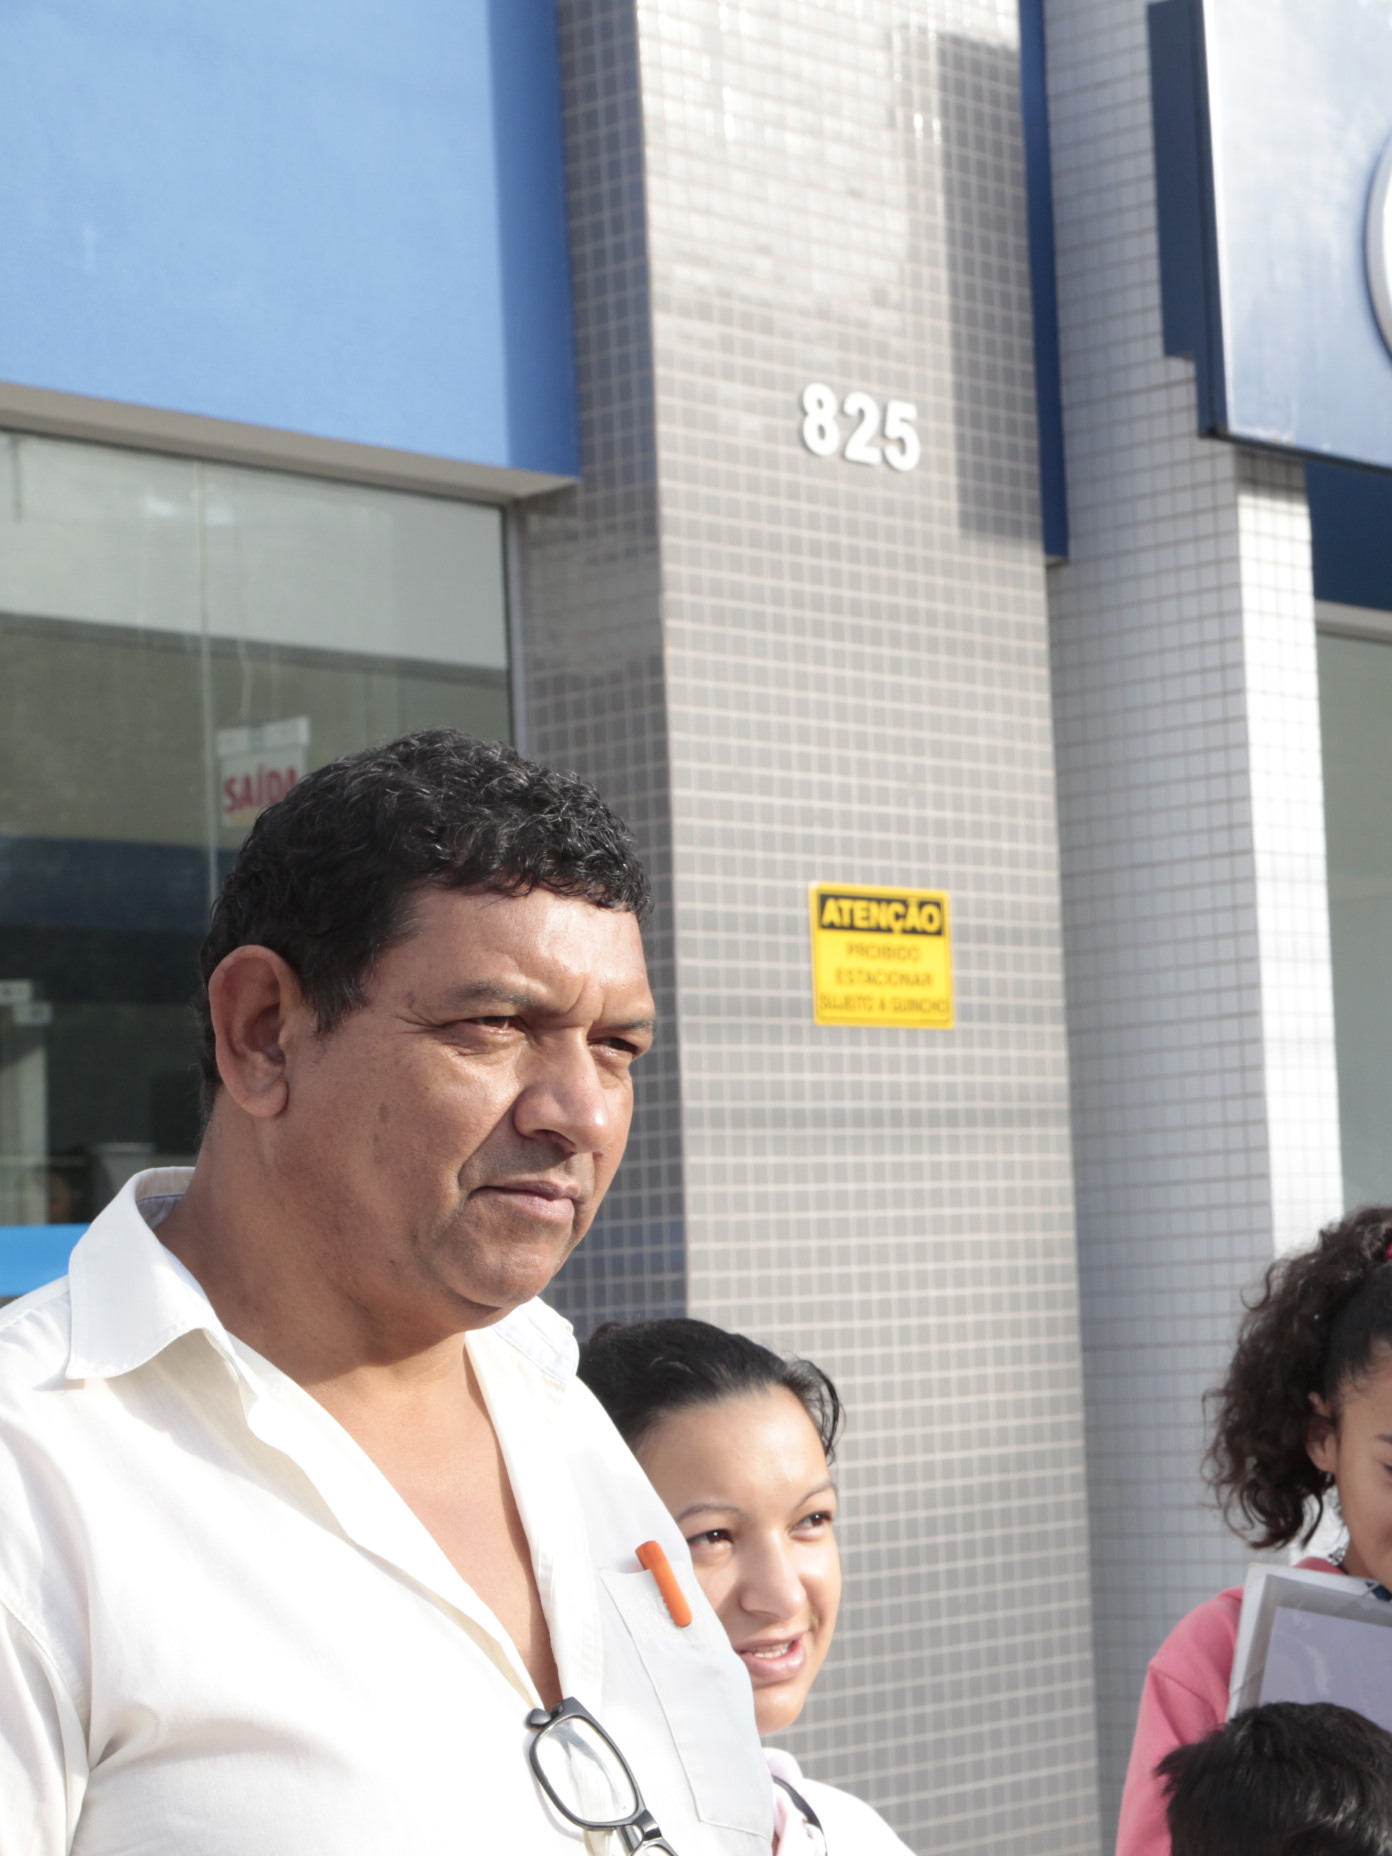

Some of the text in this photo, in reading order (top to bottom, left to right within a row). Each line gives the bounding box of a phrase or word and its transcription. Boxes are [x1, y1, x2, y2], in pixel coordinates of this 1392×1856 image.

[801, 382, 921, 472] 825
[822, 898, 942, 933] ATENÇÃO
[846, 943, 920, 961] PROIBIDO
[836, 967, 932, 986] ESTACIONAR
